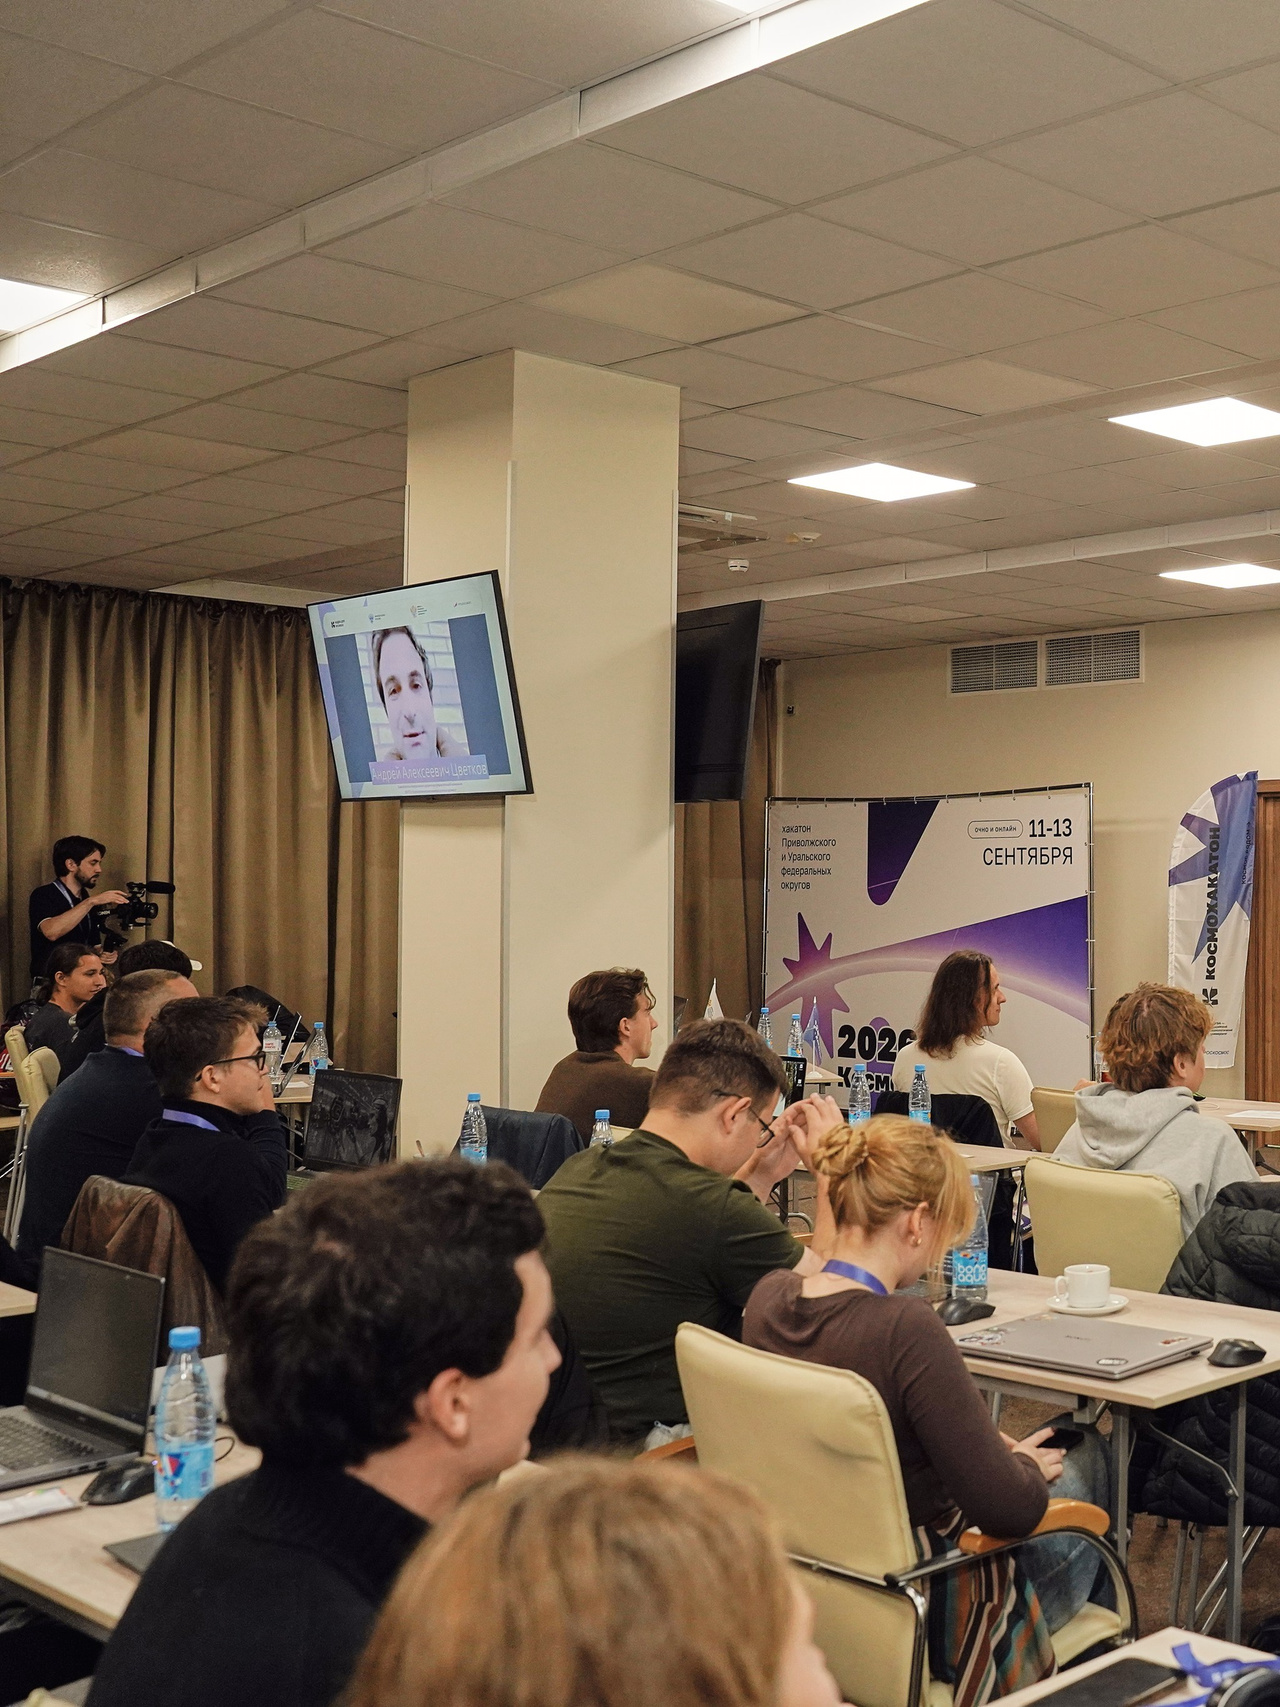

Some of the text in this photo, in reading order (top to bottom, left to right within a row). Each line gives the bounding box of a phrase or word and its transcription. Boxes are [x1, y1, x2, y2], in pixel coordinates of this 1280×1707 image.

[781, 825, 811, 833] хакатон
[1029, 818, 1072, 838] 11-13
[781, 837, 837, 849] Приволжского
[781, 851, 831, 863] и Уральского
[983, 846, 1073, 866] СЕНТЯБРЯ
[780, 866, 832, 877] федеральных
[780, 881, 811, 891] округов
[1205, 827, 1220, 980] КОСМОХАКАТОН
